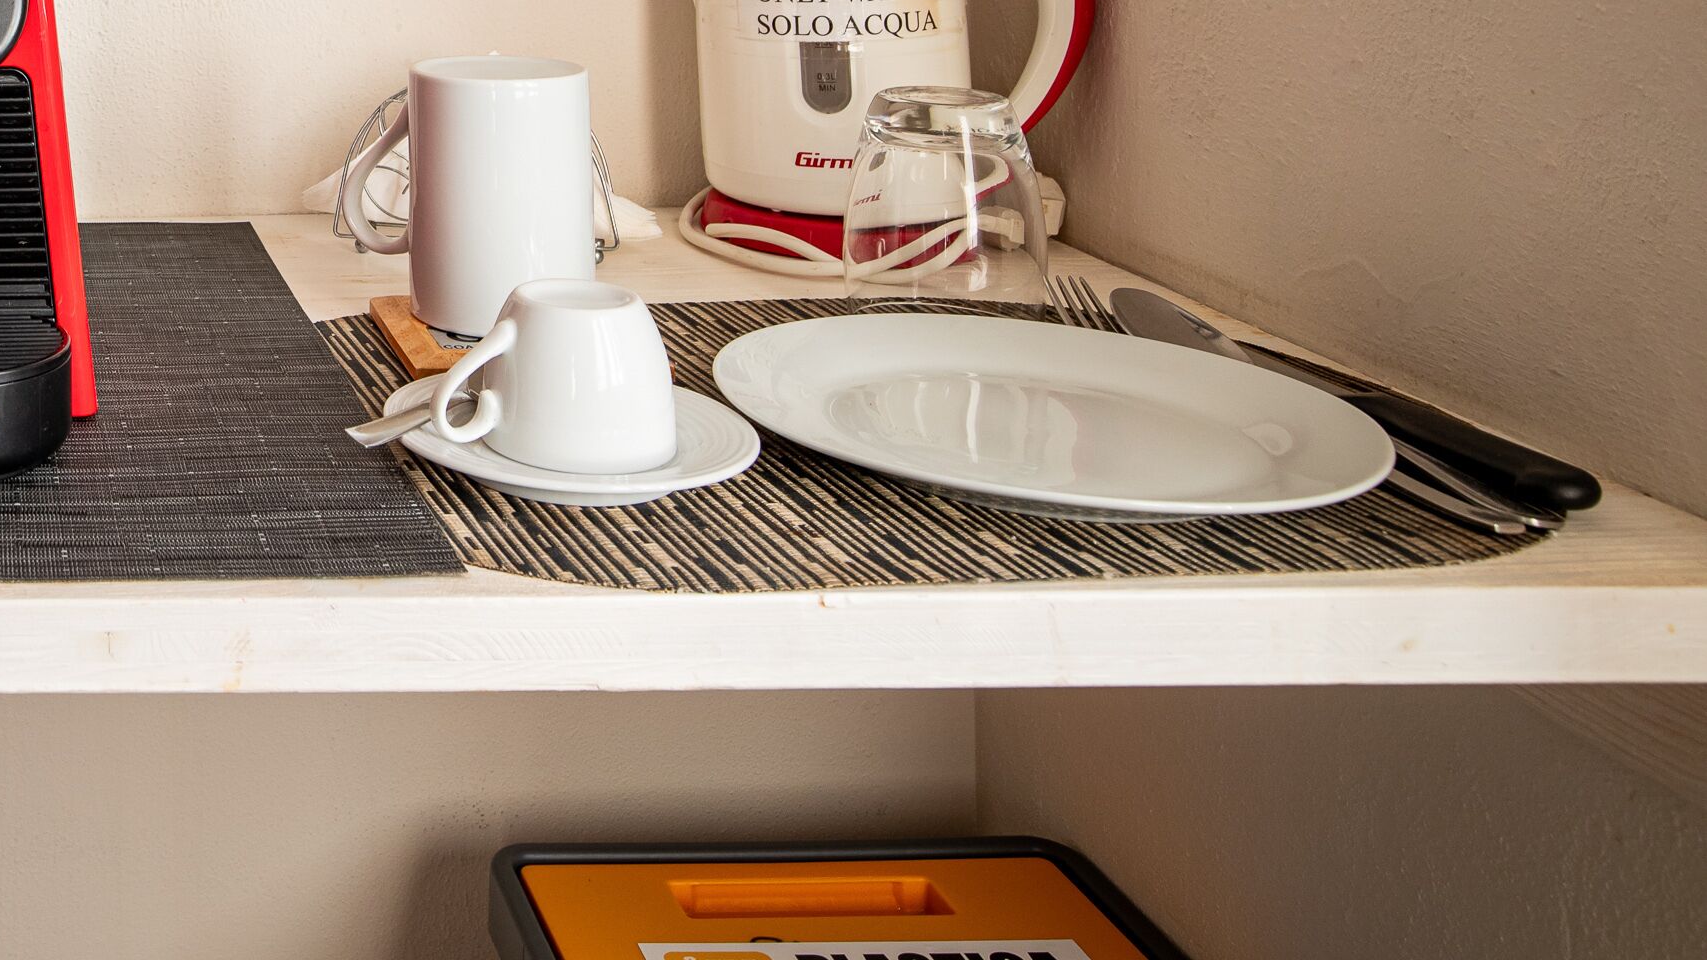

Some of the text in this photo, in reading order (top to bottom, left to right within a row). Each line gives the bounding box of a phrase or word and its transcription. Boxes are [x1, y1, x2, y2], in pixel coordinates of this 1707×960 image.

[757, 9, 938, 39] SOLO ACQUA
[816, 72, 836, 81] 03L
[818, 84, 836, 92] MIN
[794, 151, 854, 169] Girm
